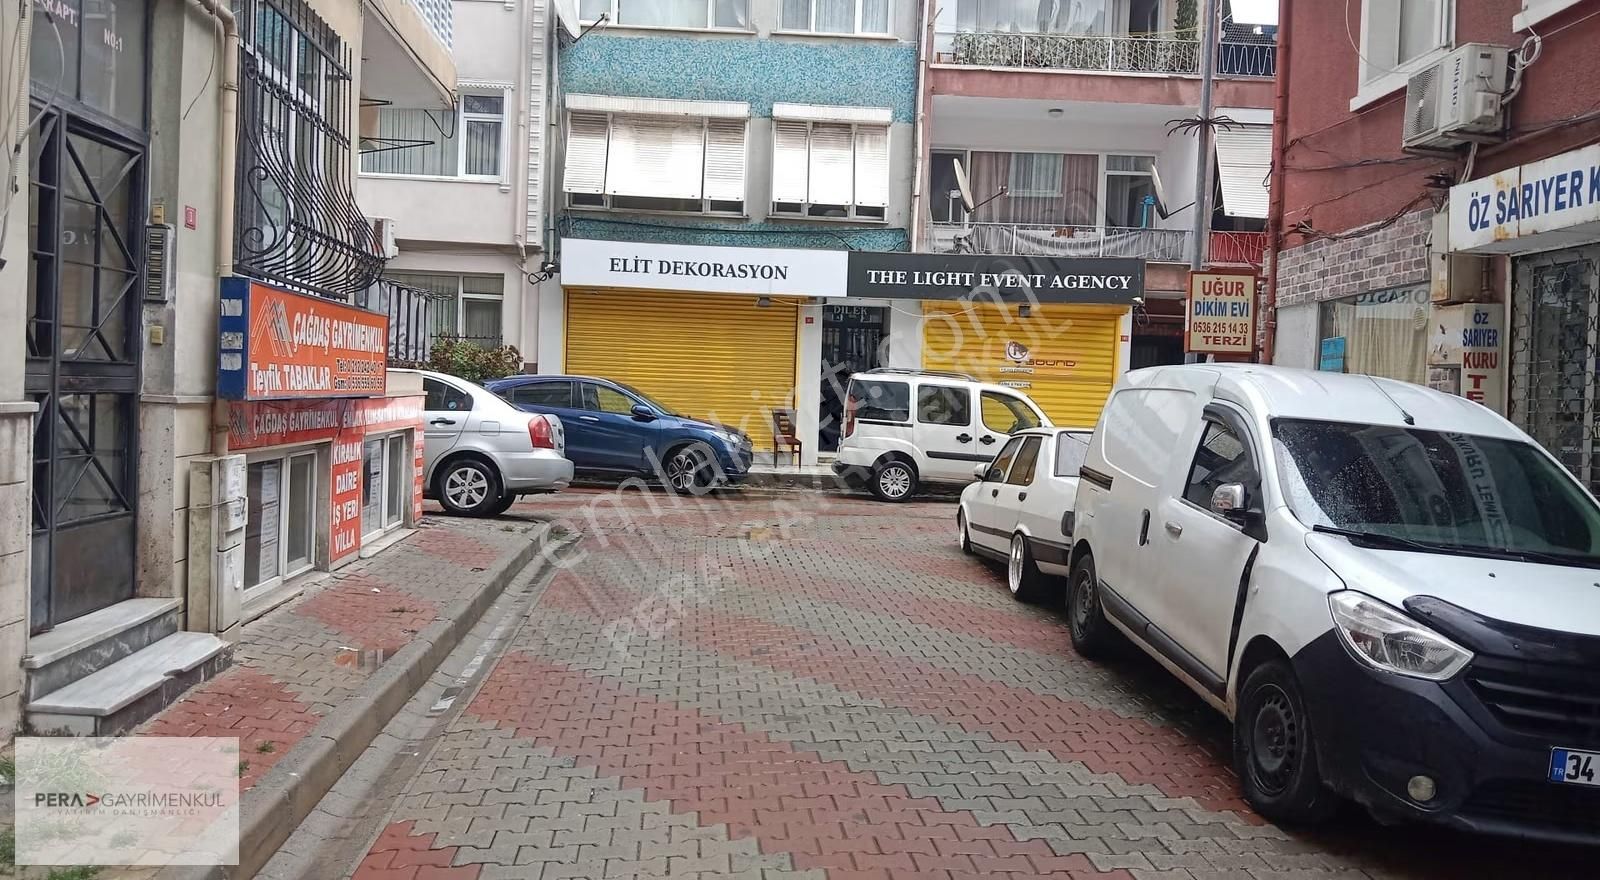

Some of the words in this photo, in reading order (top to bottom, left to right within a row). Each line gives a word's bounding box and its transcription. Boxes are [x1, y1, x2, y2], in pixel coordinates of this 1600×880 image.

[103, 28, 123, 52] NO:1
[1468, 192, 1491, 232] ÖZ
[1496, 169, 1583, 225] SARIYER
[608, 254, 653, 275] ELİT
[657, 259, 788, 281] DEKORASYON
[866, 269, 908, 286] THE
[912, 270, 975, 288] LIGHT
[980, 272, 1046, 289] EVENT
[1050, 274, 1133, 291] AGENCY
[1202, 277, 1245, 297] UĞUR
[1194, 297, 1227, 317] DİKİM
[1231, 299, 1249, 317] EVİ
[1473, 309, 1489, 325] ÖZ
[293, 307, 330, 356] ÇAĞDAŞ
[332, 316, 384, 354] GAYRİMENKUL
[1193, 322, 1211, 333] 0536
[1213, 322, 1226, 334] 215
[1228, 322, 1237, 334] 14
[1239, 323, 1249, 334] 33
[1202, 334, 1247, 346] TERZİ
[1462, 328, 1498, 347] SARIYER
[1463, 351, 1498, 369] KURU
[283, 364, 331, 391] TABAKLAR
[253, 409, 288, 440] ÇAĞDAŞ
[289, 408, 339, 432] GAYRİMENKUL
[333, 440, 362, 465] KİRALIK
[335, 467, 358, 495] DAİRE
[332, 501, 341, 529] İŞ
[342, 493, 359, 521] YERİ
[334, 528, 356, 554] VİLLA
[1553, 767, 1565, 777] TR
[1565, 754, 1595, 782] 34
